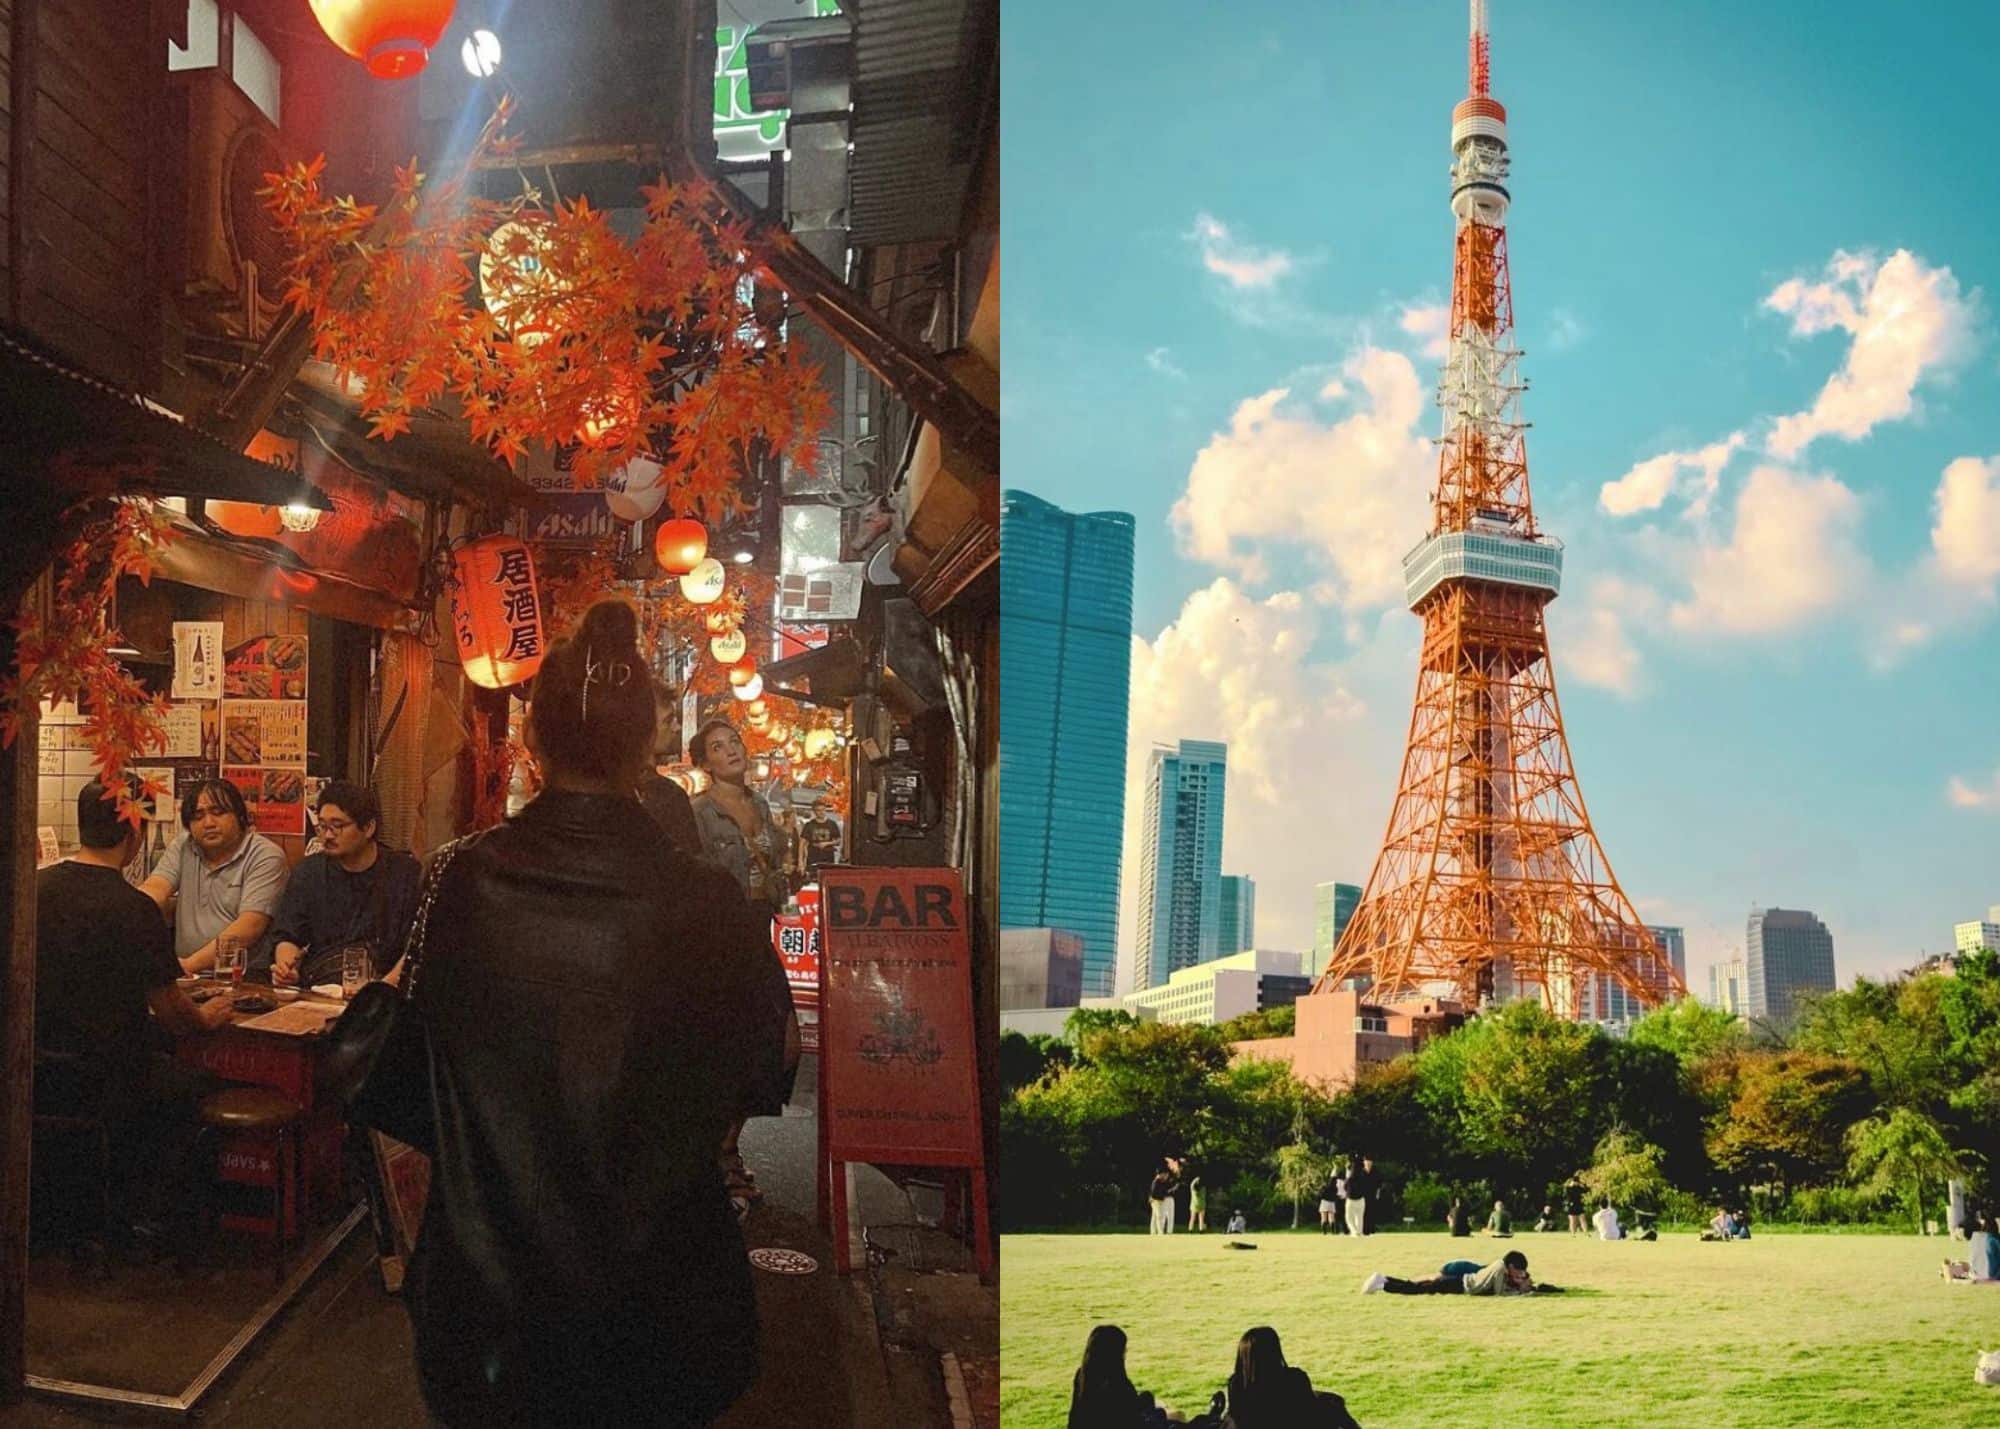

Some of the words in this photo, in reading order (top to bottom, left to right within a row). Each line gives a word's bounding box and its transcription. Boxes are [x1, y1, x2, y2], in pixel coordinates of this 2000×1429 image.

[536, 506, 615, 537] Asahi
[495, 551, 538, 660] 居酒屋
[829, 885, 958, 928] BAR
